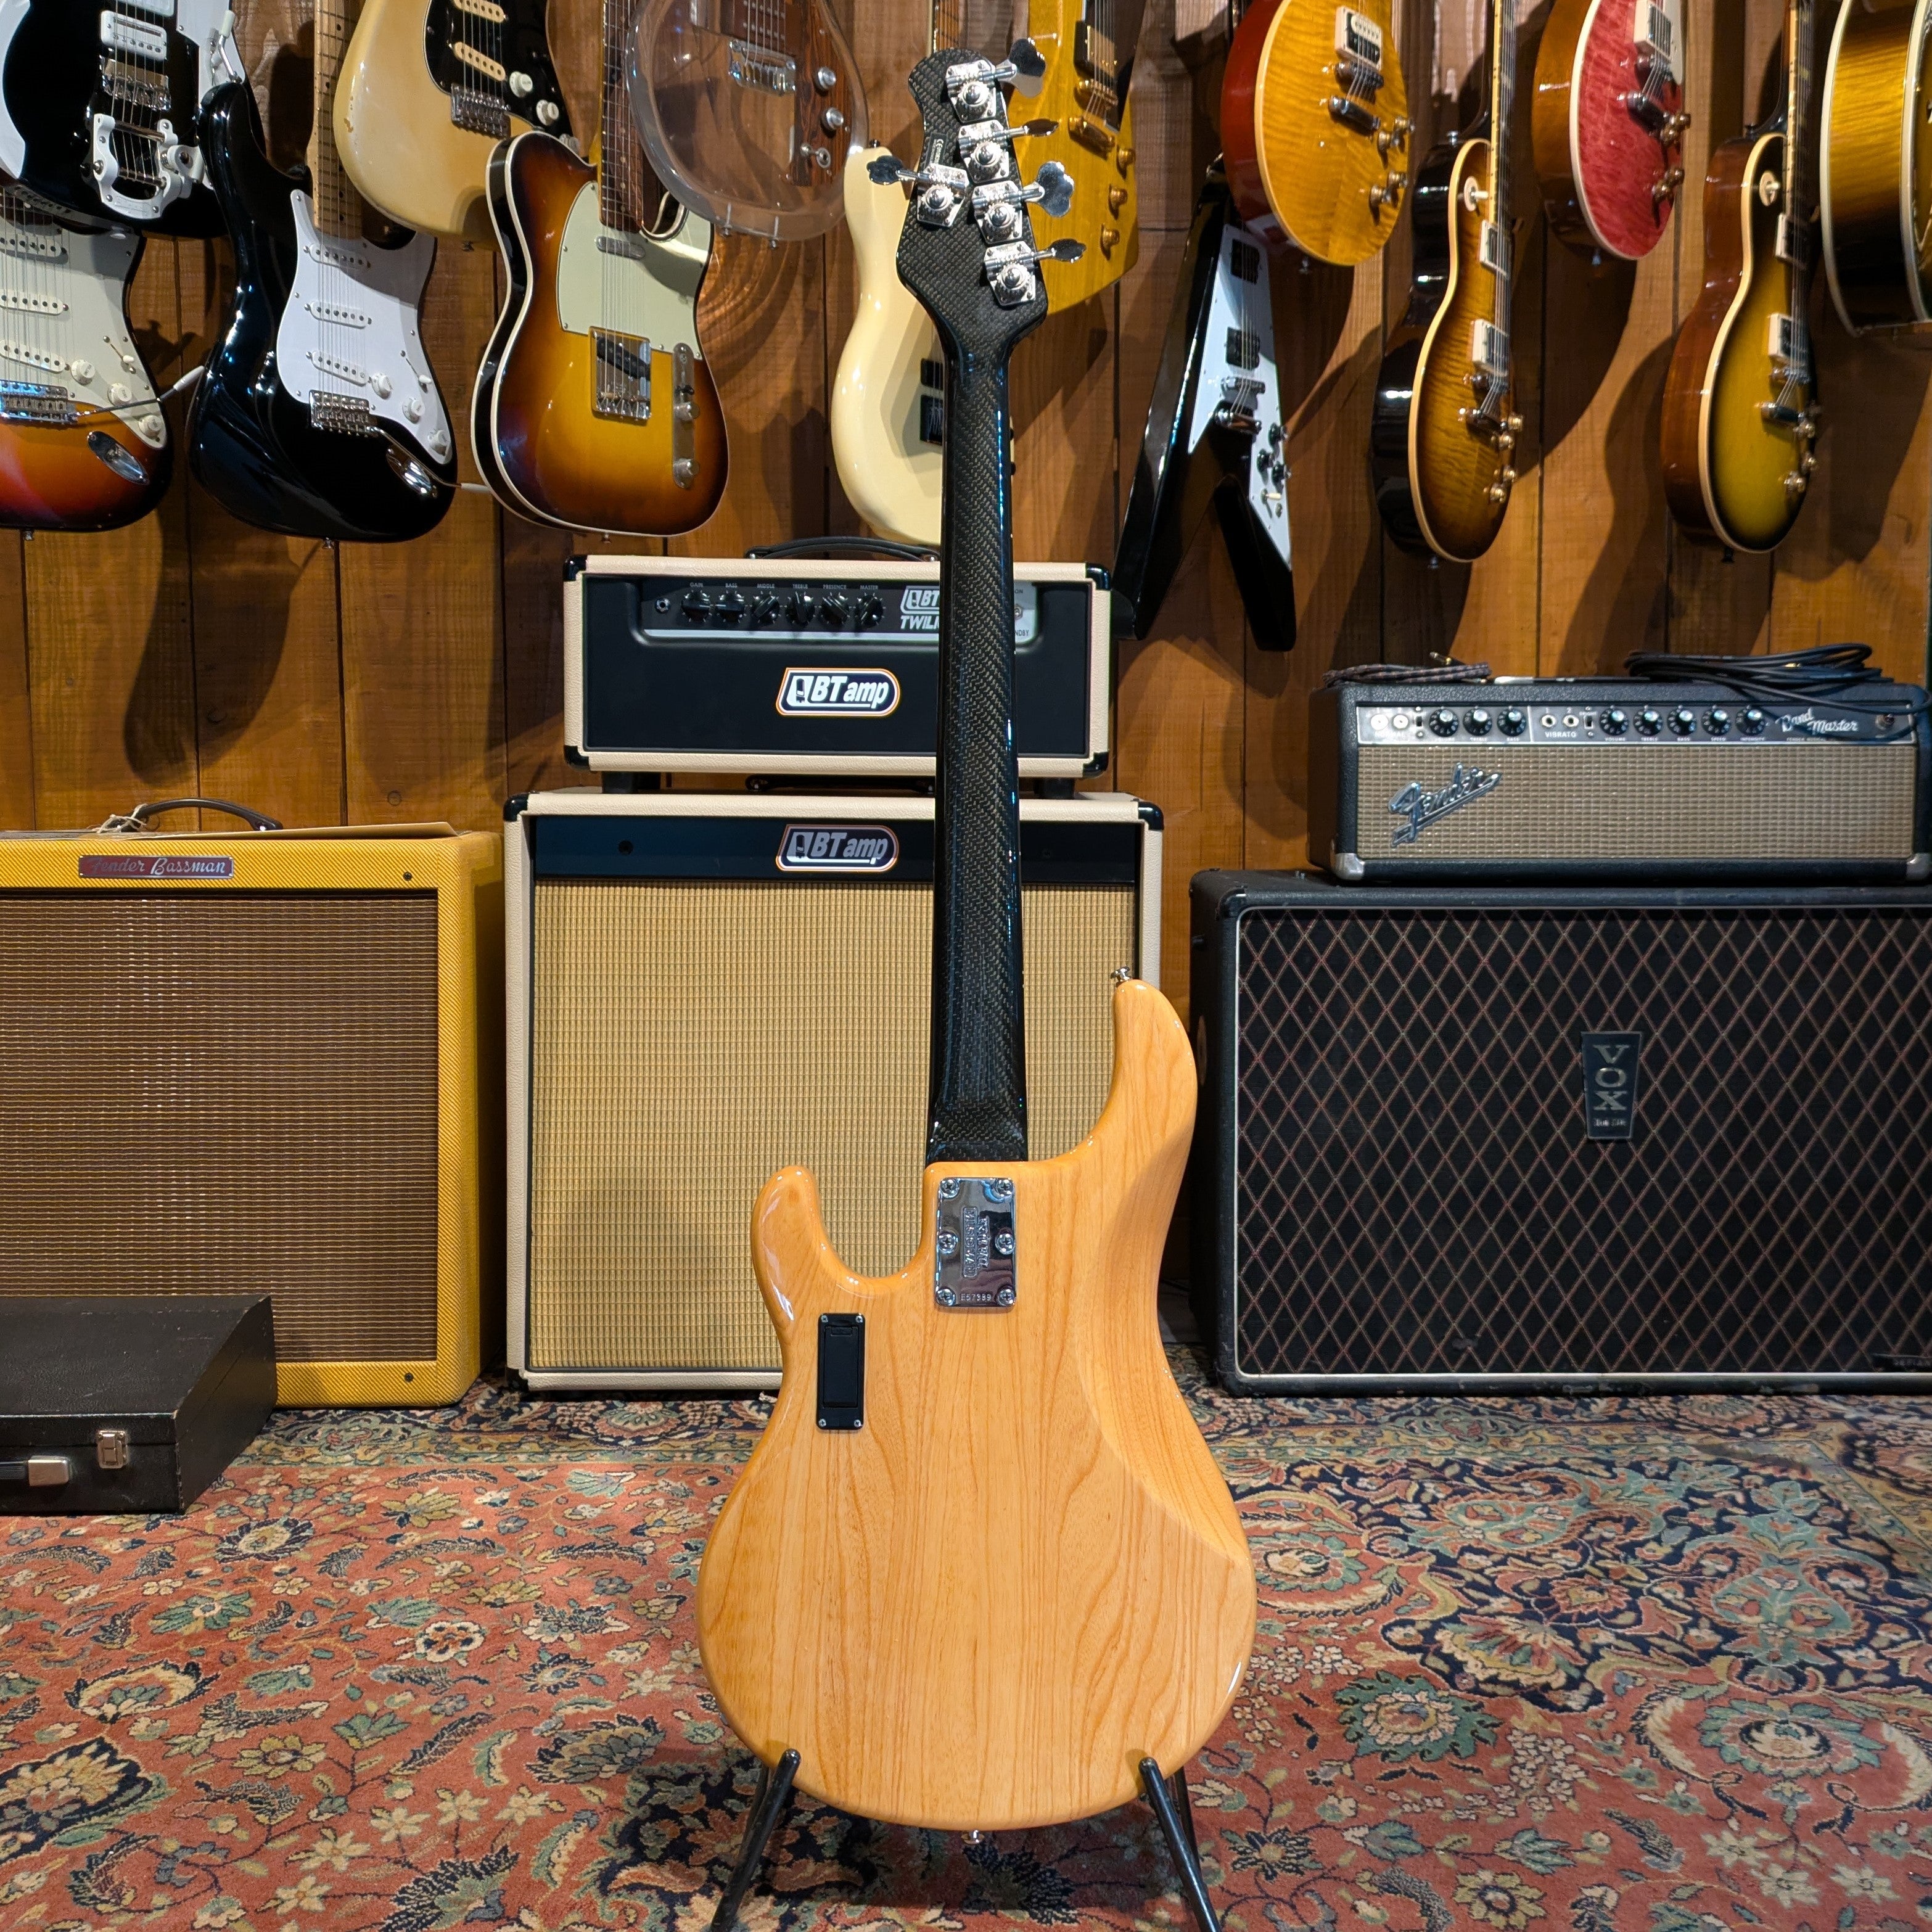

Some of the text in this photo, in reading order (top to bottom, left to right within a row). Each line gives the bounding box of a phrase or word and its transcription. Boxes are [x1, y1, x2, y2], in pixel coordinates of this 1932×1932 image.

[843, 681, 889, 709] amp
[1775, 707, 1859, 735] Band Master
[1388, 762, 1502, 848] Fender
[842, 838, 888, 865] amp
[88, 857, 225, 875] Fender Bassman
[1593, 1045, 1629, 1110] VOX
